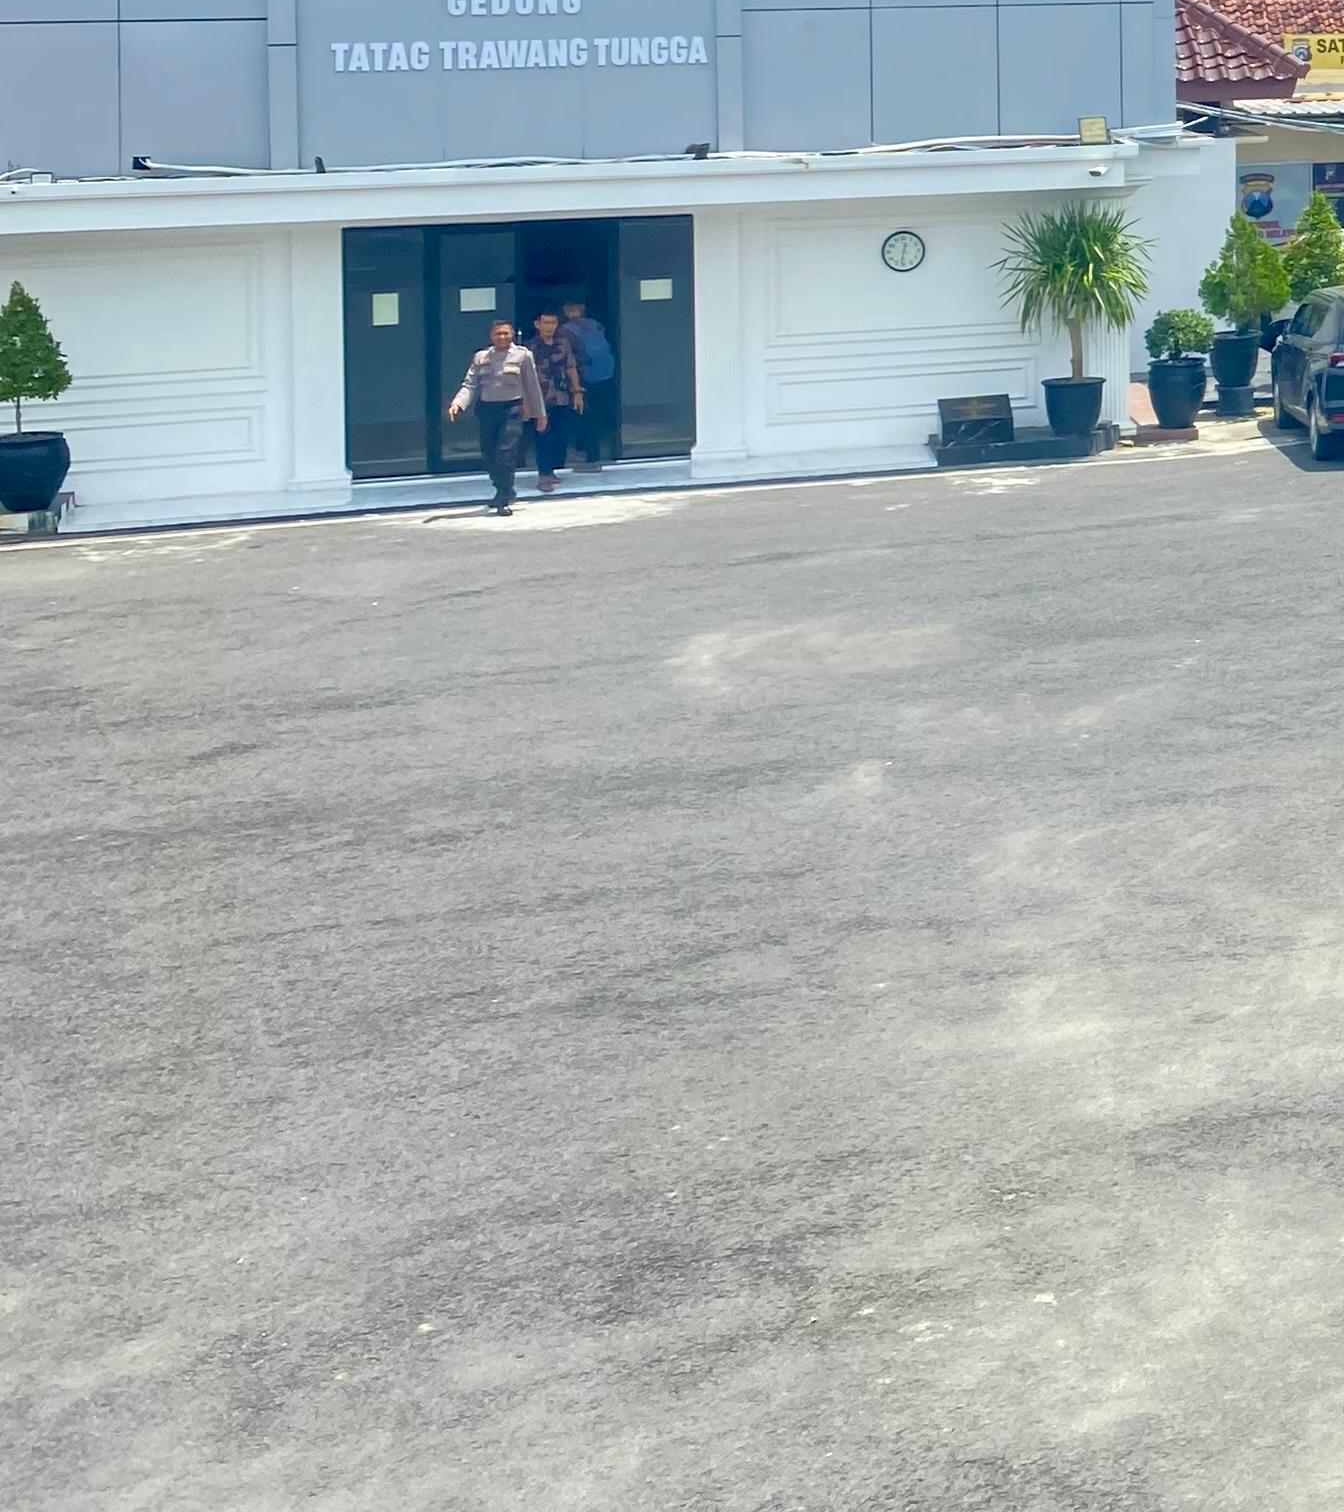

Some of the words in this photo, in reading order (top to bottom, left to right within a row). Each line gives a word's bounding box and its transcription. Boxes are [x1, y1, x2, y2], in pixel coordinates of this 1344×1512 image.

[330, 40, 430, 73] TATAG
[440, 36, 589, 70] TRAWANG
[594, 35, 708, 68] TUNGGA
